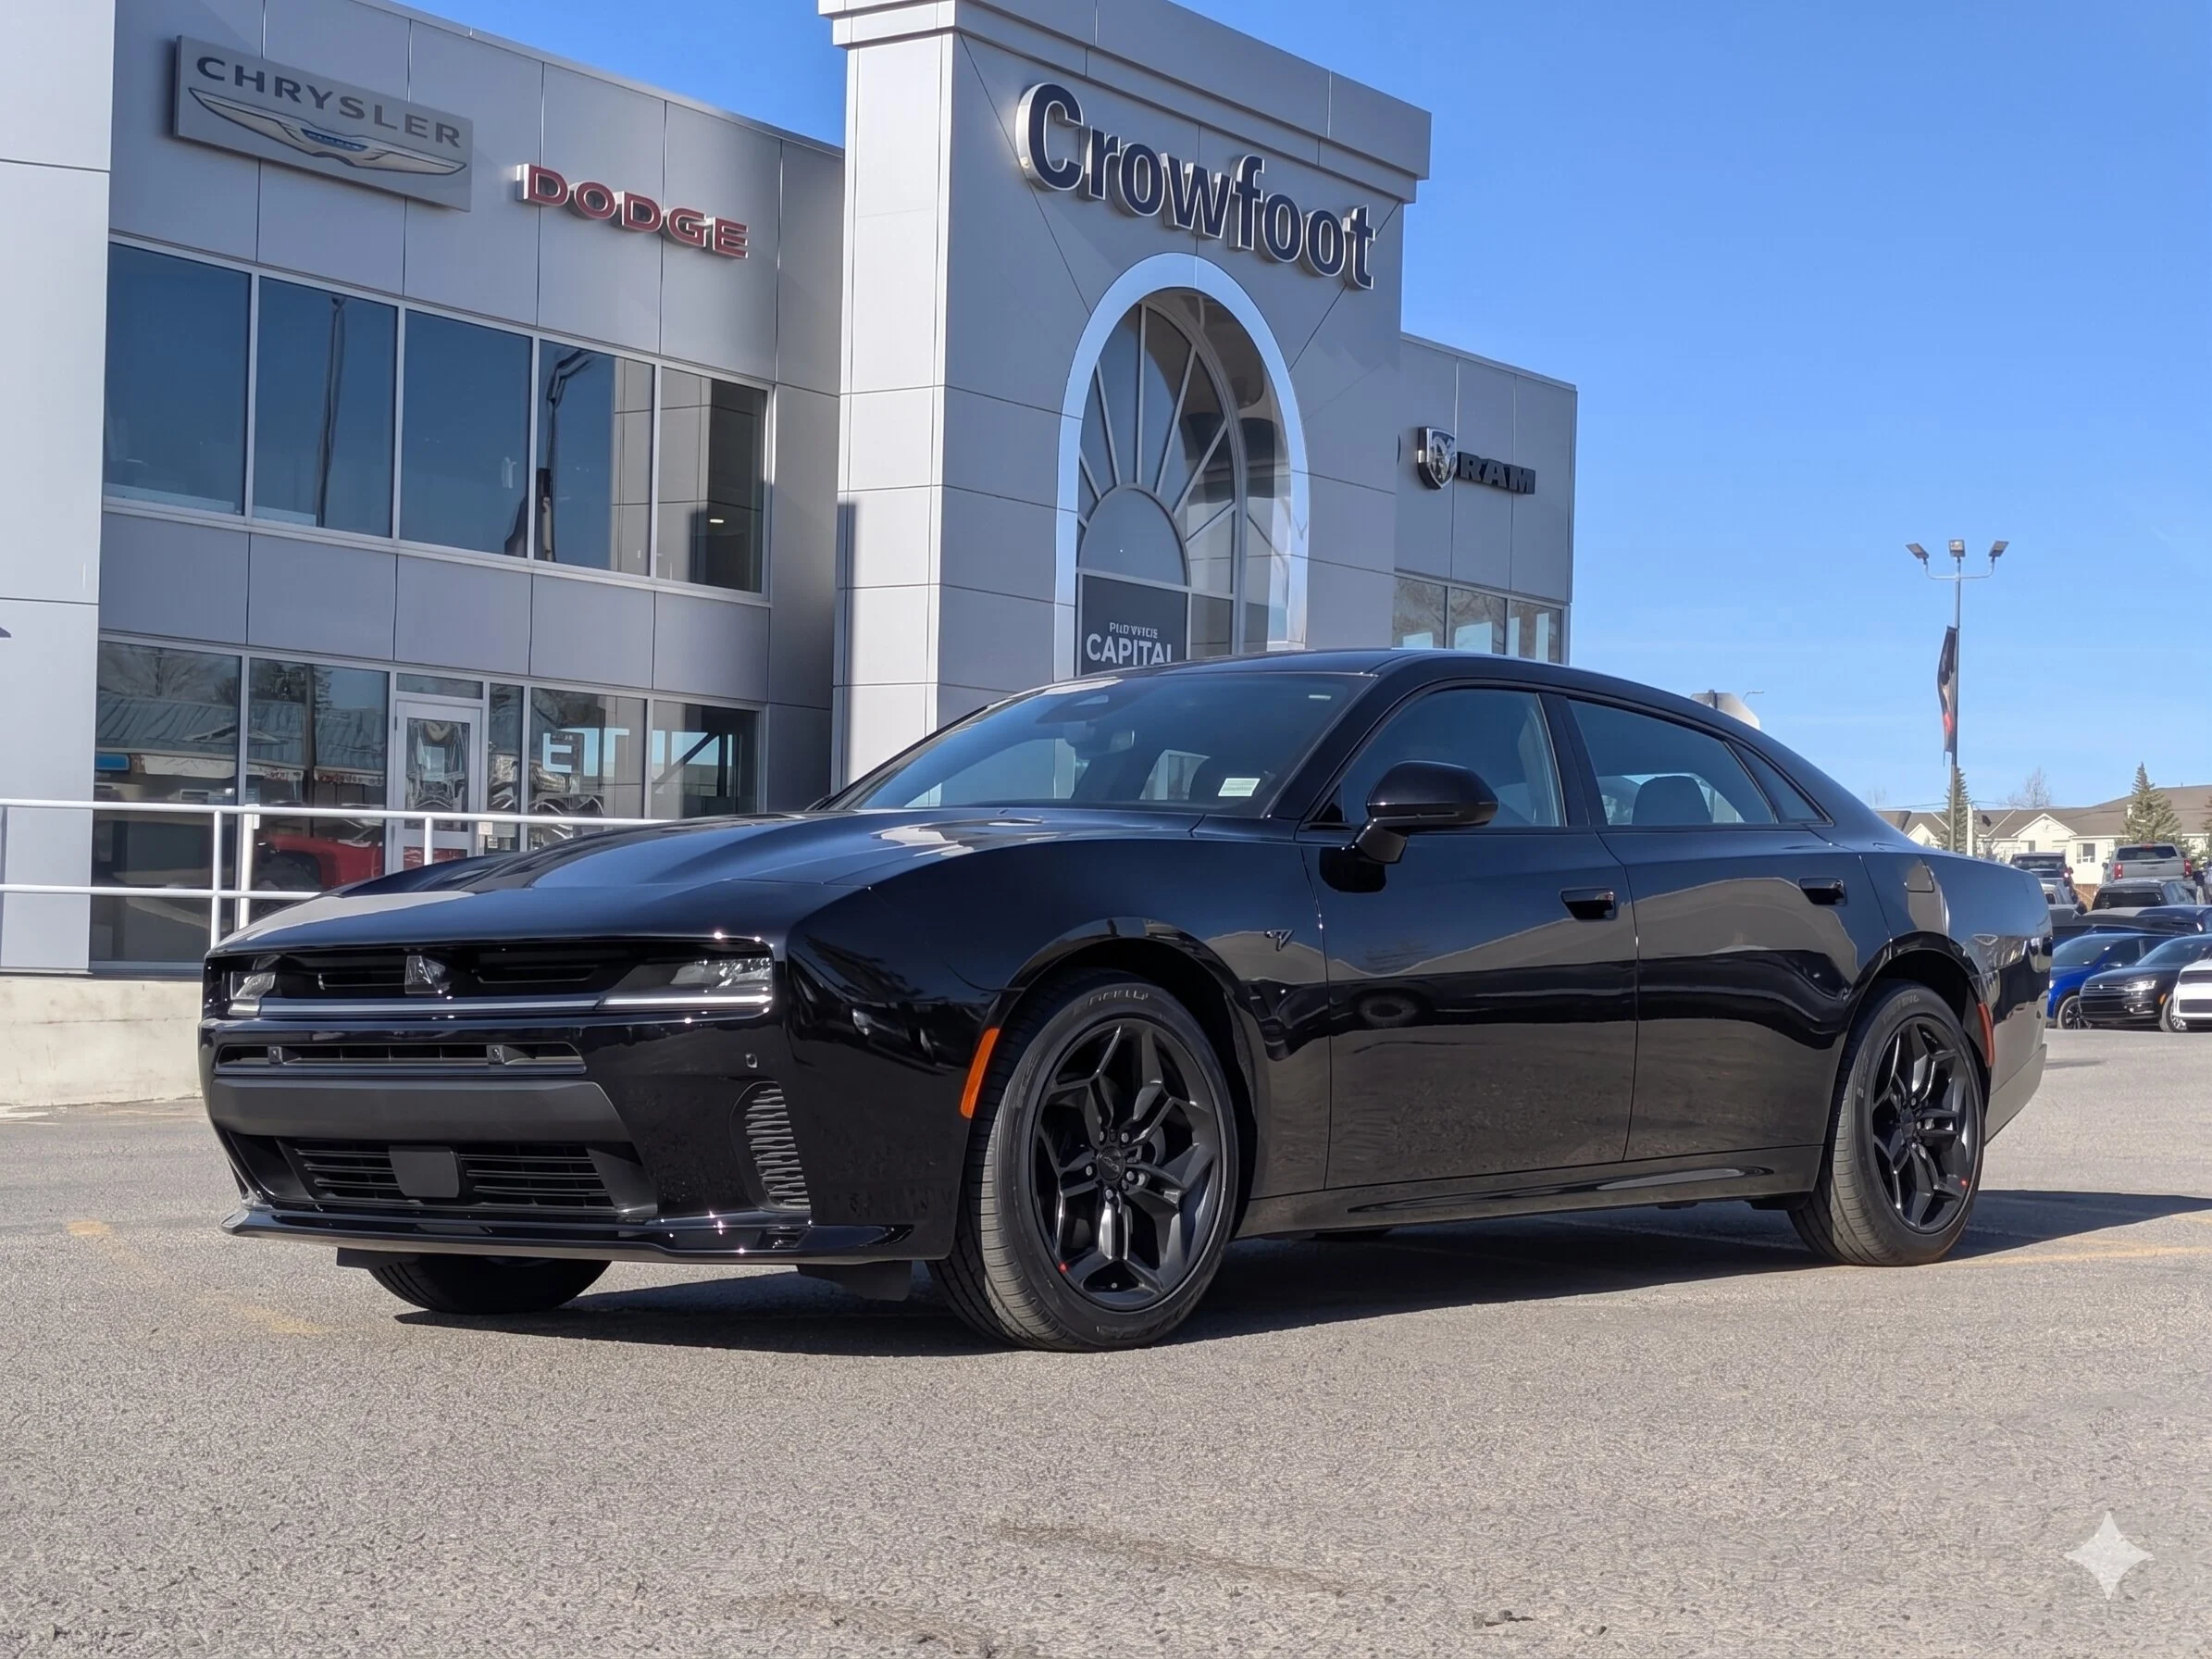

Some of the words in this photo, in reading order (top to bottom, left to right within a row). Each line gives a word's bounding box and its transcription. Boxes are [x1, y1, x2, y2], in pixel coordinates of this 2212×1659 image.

[196, 56, 461, 148] CHRYSLER
[516, 163, 749, 259] DODGE
[1015, 81, 1375, 290] Crowfoot
[1457, 451, 1536, 494] RAM
